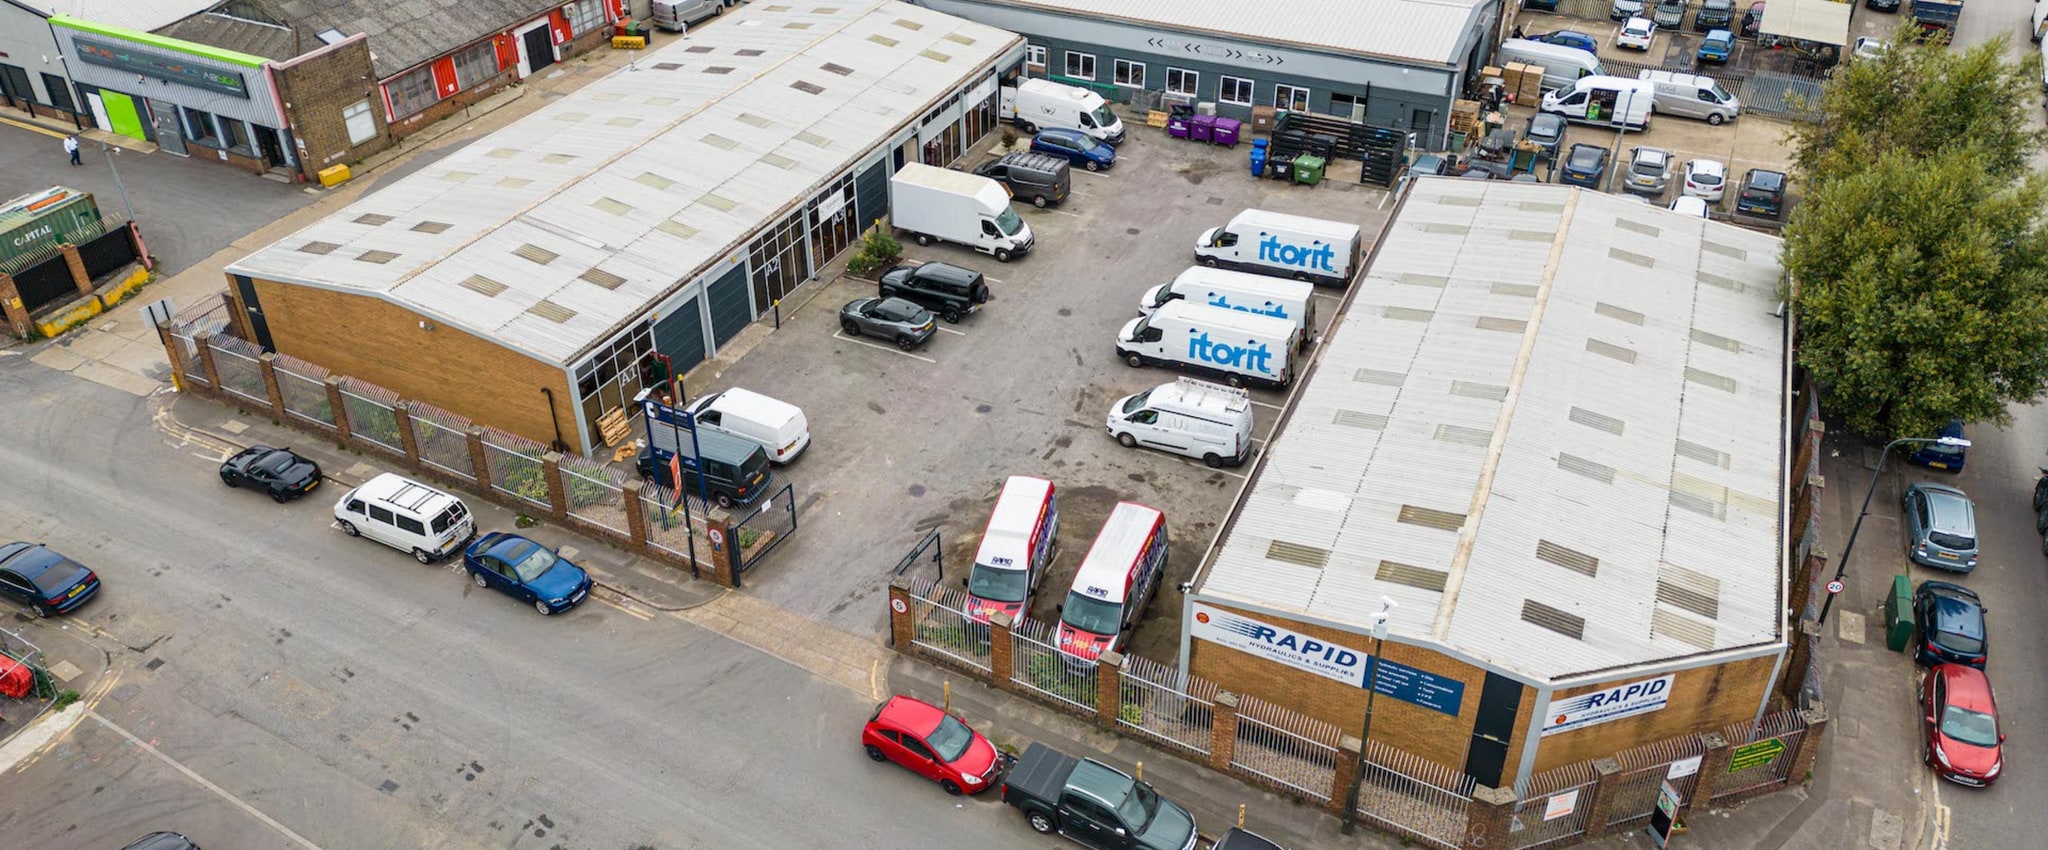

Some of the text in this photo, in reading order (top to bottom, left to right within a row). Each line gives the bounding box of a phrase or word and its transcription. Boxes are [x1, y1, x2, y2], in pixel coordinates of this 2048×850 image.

[14, 225, 52, 246] CAPITAL
[766, 256, 780, 277] A2
[1258, 231, 1335, 272] itorit
[1189, 327, 1272, 374] itorit
[621, 366, 638, 388] A1
[1248, 641, 1303, 661] HYDRAULICS
[1313, 661, 1356, 678] SUPPLIES
[1254, 625, 1358, 668] RAPID
[1580, 705, 1622, 718] HYDRAULICS
[1630, 696, 1662, 707] SUPPLIES
[1587, 679, 1667, 709] RAPID
